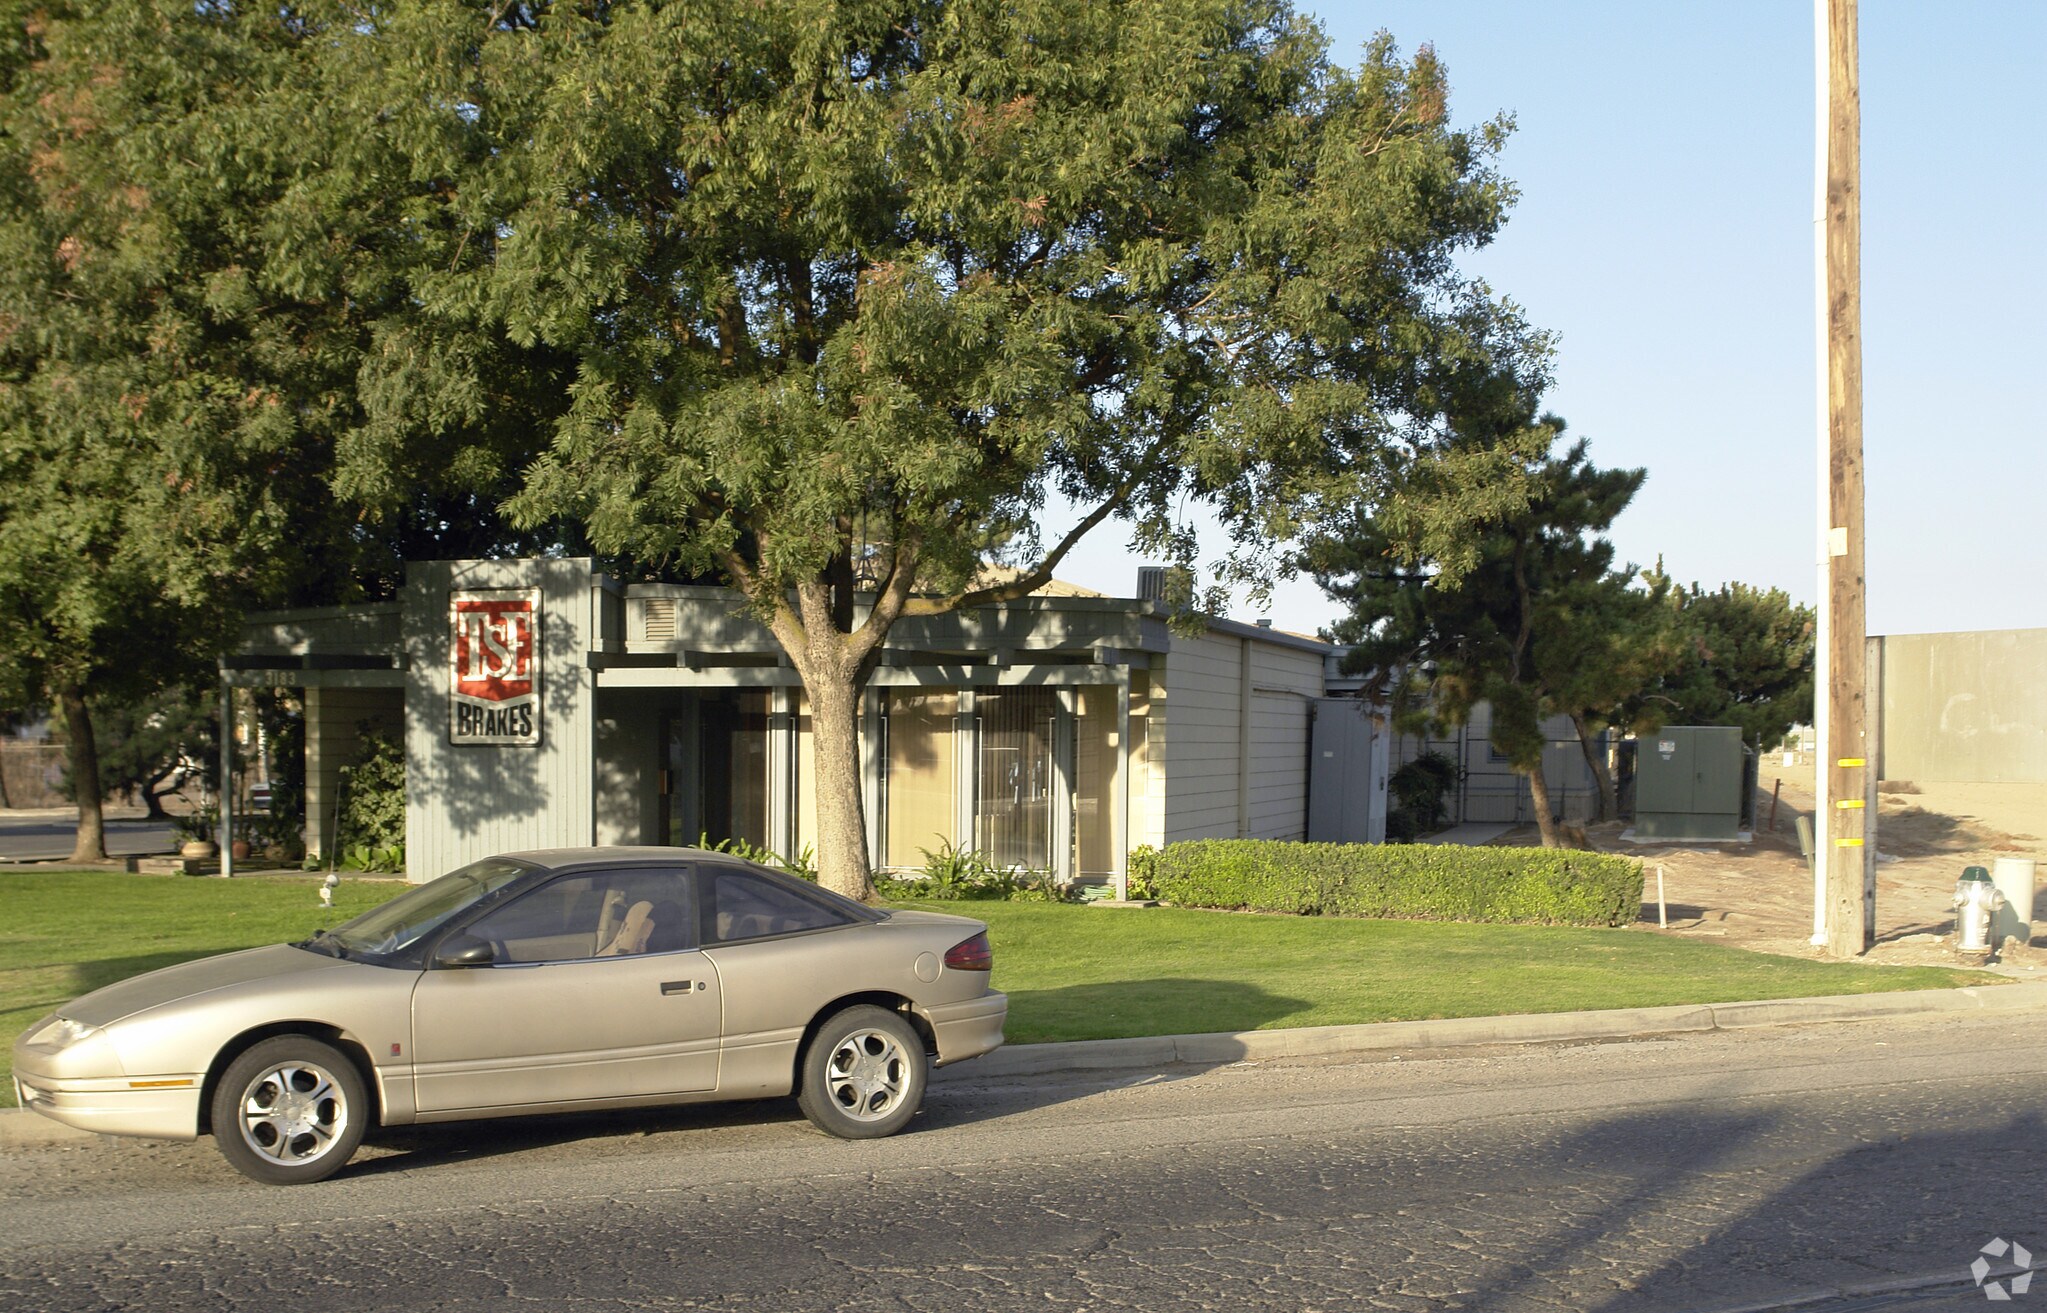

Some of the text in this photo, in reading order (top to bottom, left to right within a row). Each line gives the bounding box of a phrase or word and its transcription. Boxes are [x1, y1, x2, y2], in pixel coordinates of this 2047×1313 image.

[458, 612, 531, 681] TSE
[265, 671, 296, 686] 3183
[457, 701, 532, 737] BRAKES
